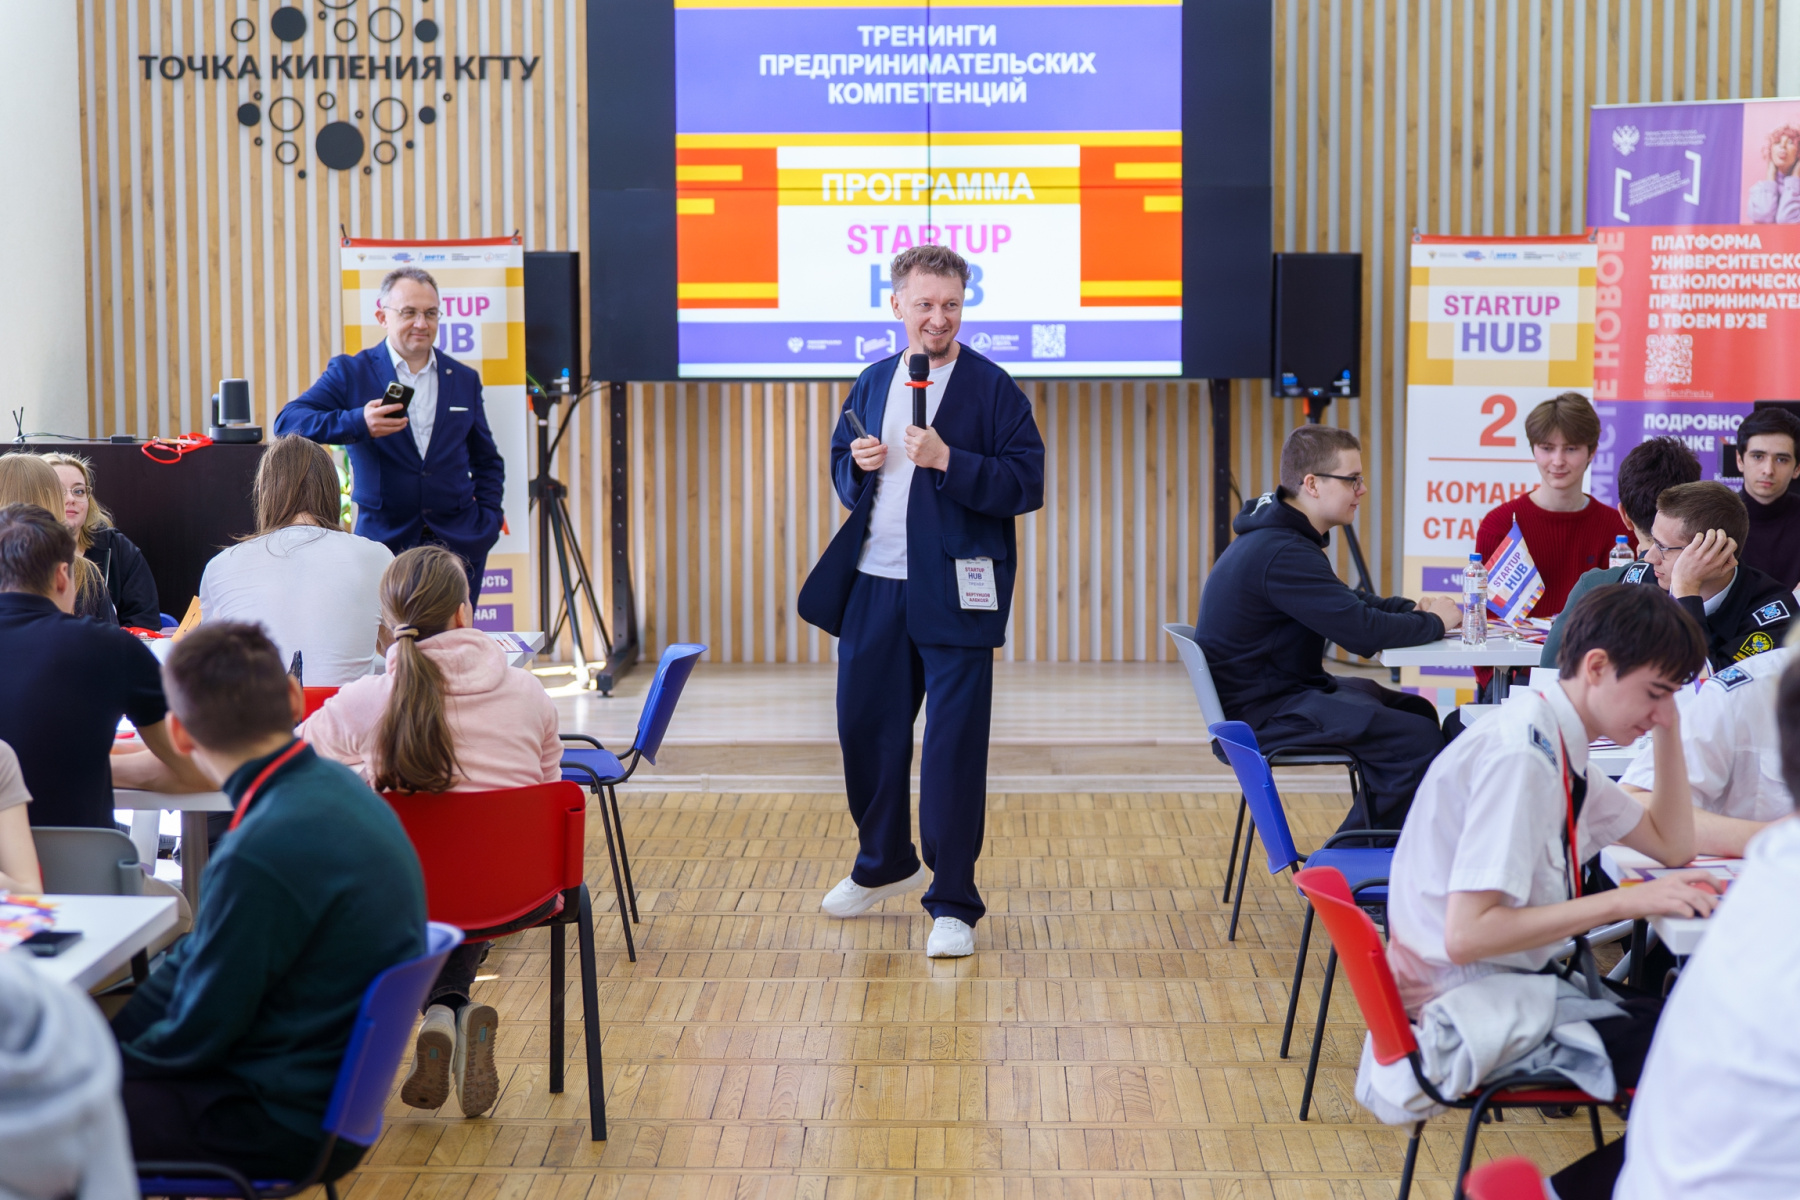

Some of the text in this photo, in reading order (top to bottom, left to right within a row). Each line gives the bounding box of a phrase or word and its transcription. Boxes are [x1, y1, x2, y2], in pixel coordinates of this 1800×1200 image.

[857, 24, 997, 47] ТРЕНИНГИ
[138, 54, 540, 81] ТОЧКА КИПЕНИЯ КГТУ
[759, 52, 1097, 79] ПРЕДПРИНИМАТЕЛЬСКИХ
[828, 76, 1028, 107] КОМПЕТЕНЦИЙ
[821, 172, 1036, 202] ПРОГРАММА
[847, 223, 1013, 255] STARTUP
[1650, 233, 1763, 251] ПЛАТФОРМА
[870, 263, 985, 308] HB
[1649, 272, 1800, 290] ТЕХНОЛОГИЧЕСК
[1443, 294, 1561, 317] STARTUP
[1648, 292, 1800, 311] ПРЕДПРИНИМАТЕ
[1647, 312, 1768, 330] В ТВОЕМ ВУЗЕ
[1461, 321, 1542, 353] HUB
[1479, 393, 1518, 447] 2
[1643, 412, 1745, 433] ПОДРОБНО
[1422, 516, 1483, 540] СТА
[967, 572, 983, 580] HUB
[1492, 551, 1522, 588] STARTUP
[1504, 562, 1529, 591] HUB
